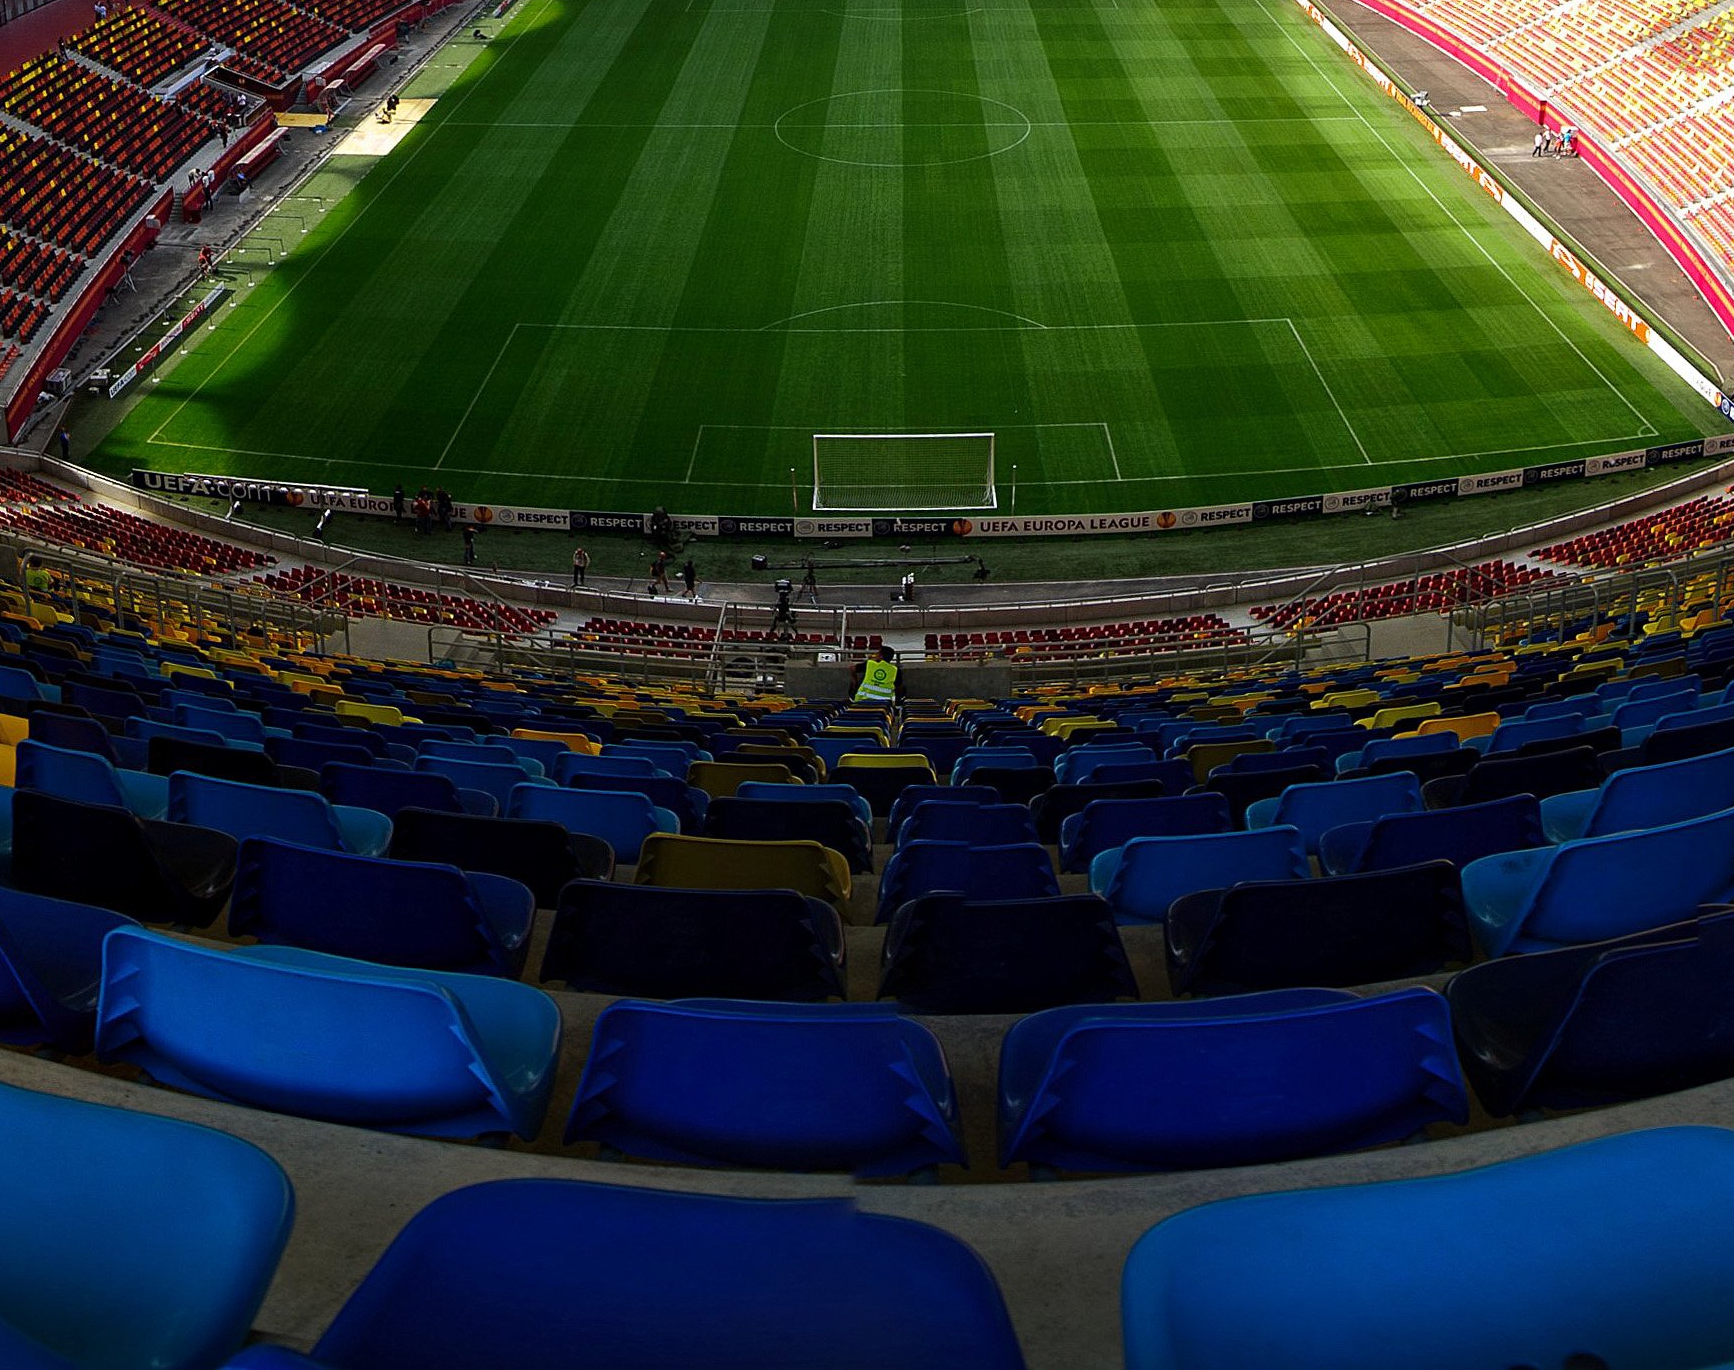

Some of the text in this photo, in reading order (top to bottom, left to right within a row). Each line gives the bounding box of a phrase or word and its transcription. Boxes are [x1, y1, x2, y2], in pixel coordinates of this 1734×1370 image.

[1593, 278, 1643, 331] SEAT
[1662, 444, 1702, 459] RESPECT
[1541, 465, 1585, 479] RESPECT
[1476, 473, 1522, 488] RESPECT
[1410, 483, 1457, 498] RESPECT
[1342, 492, 1391, 507] RESPECT
[350, 498, 407, 513] EURO
[411, 504, 467, 518] LUE
[1200, 508, 1251, 522] RESPECT
[1272, 501, 1322, 515] RESPECT
[517, 512, 568, 525] RESPECT
[590, 517, 643, 528] RESPECT
[672, 520, 717, 531] ESPECT
[980, 517, 1150, 533] UEFA EUROPA LEAGUE
[740, 522, 792, 532] RESPECT
[818, 522, 870, 532] RESPECT
[893, 522, 946, 532] RESPECT
